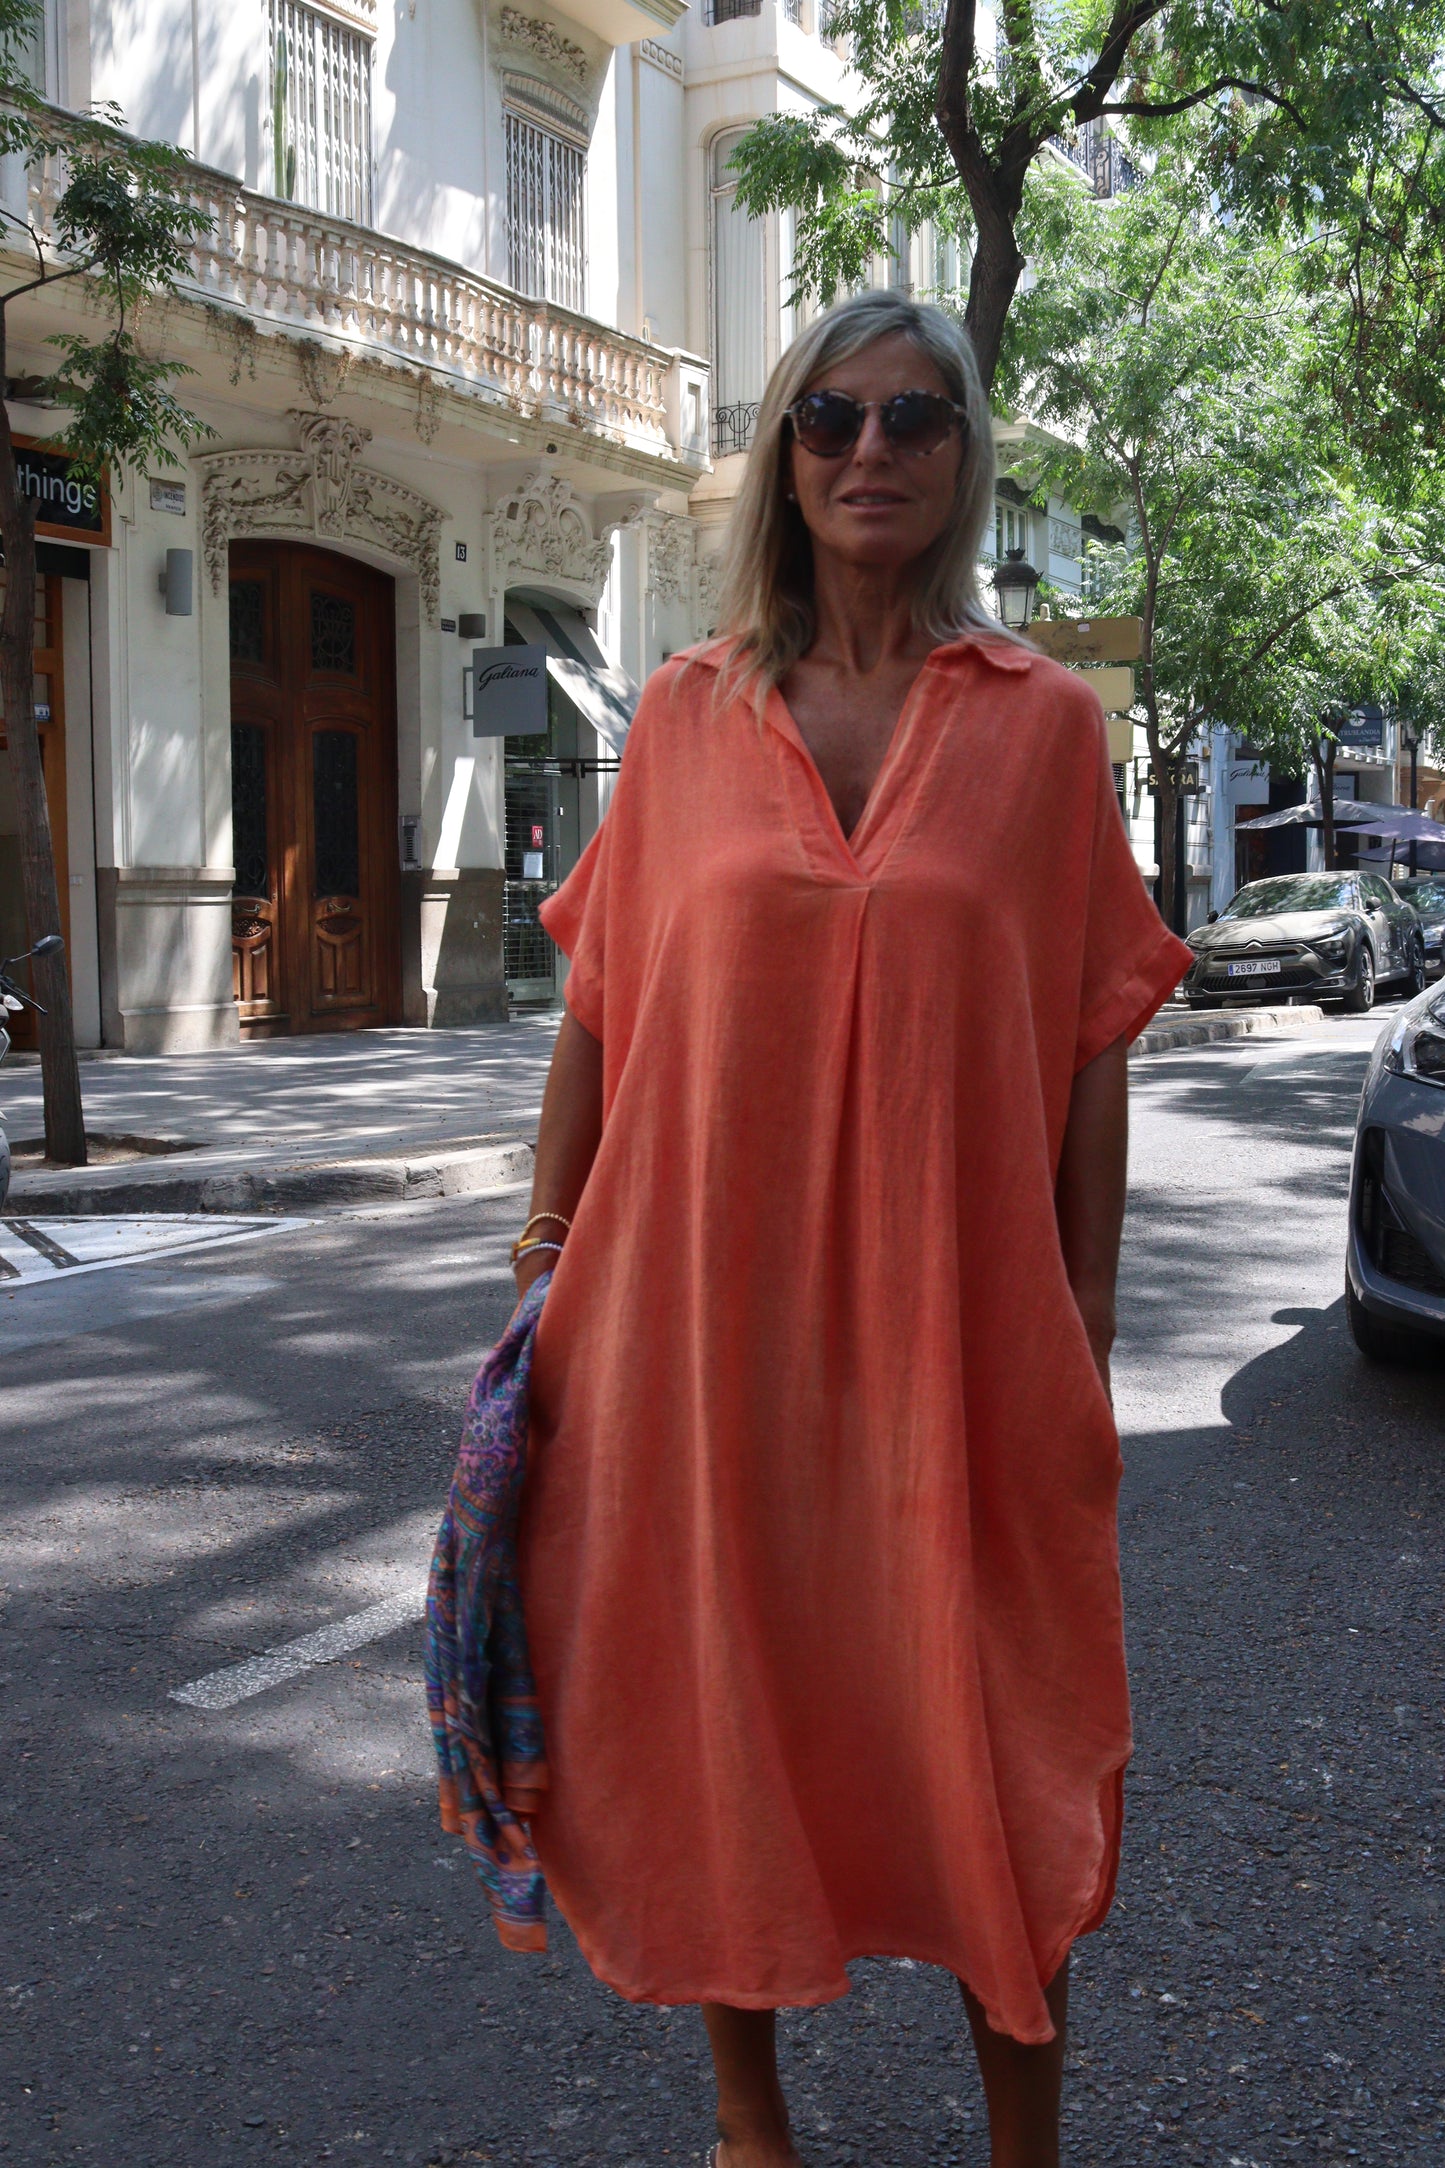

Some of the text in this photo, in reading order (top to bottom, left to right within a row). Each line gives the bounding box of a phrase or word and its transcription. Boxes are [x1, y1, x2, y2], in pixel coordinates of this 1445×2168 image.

[17, 464, 97, 514] things
[457, 545, 466, 559] 13
[478, 662, 539, 691] Galiana
[1235, 961, 1278, 974] 2697 NGH
